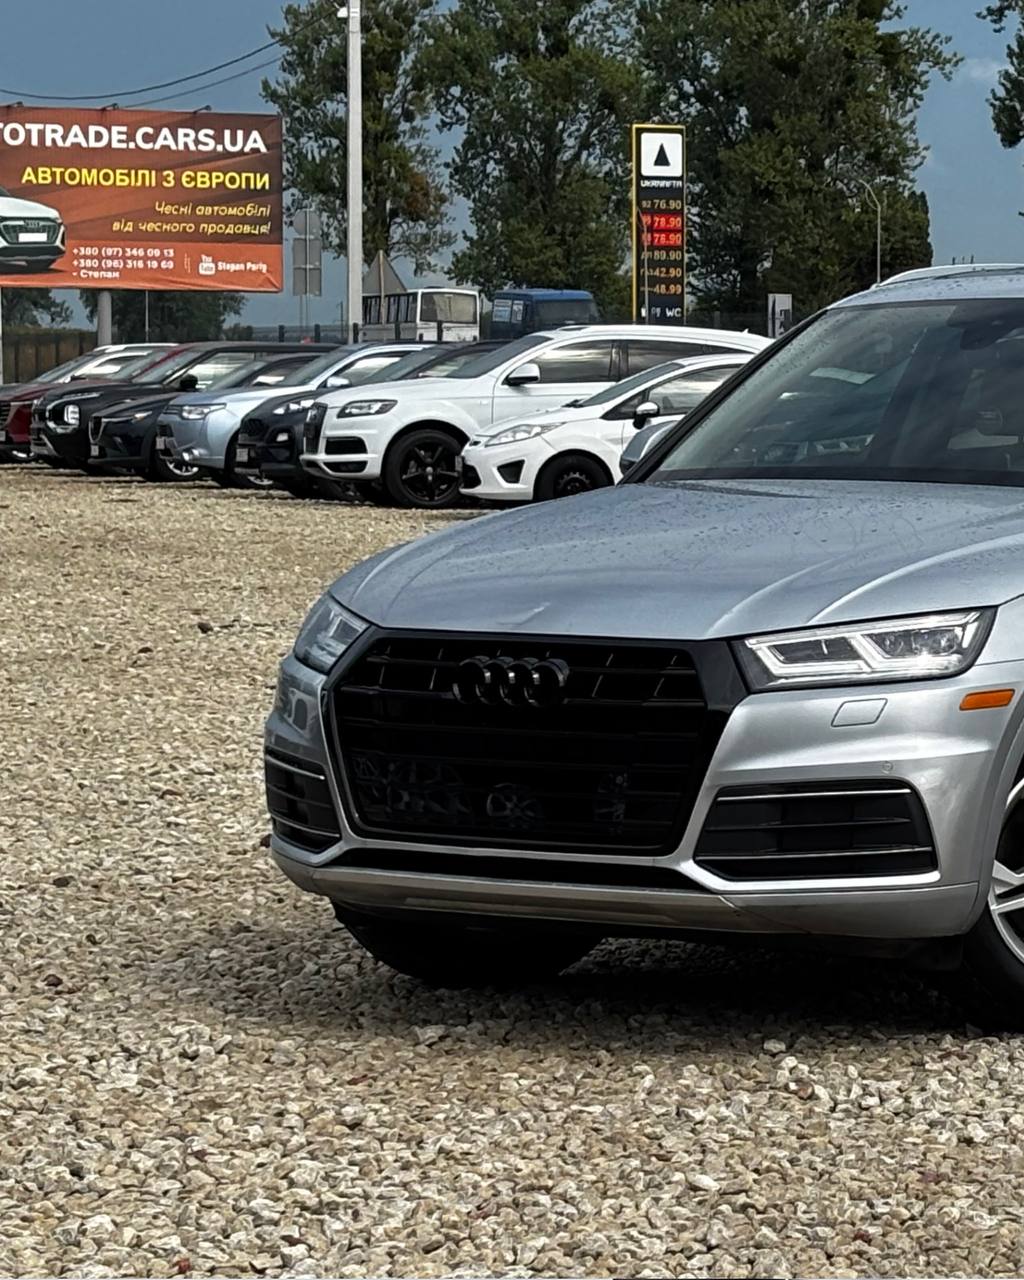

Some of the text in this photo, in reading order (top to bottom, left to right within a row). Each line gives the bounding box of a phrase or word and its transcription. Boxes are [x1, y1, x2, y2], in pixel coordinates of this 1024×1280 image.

[0, 122, 268, 153] OTRADE.CARS.UA
[21, 166, 156, 187] АВТОМОБІЛІ
[181, 171, 270, 190] ЄВРОПИ
[155, 201, 271, 218] Чесні автомобілі
[112, 218, 272, 236] від чесного продавця!
[80, 269, 120, 279] Степан
[665, 307, 682, 317] WC
